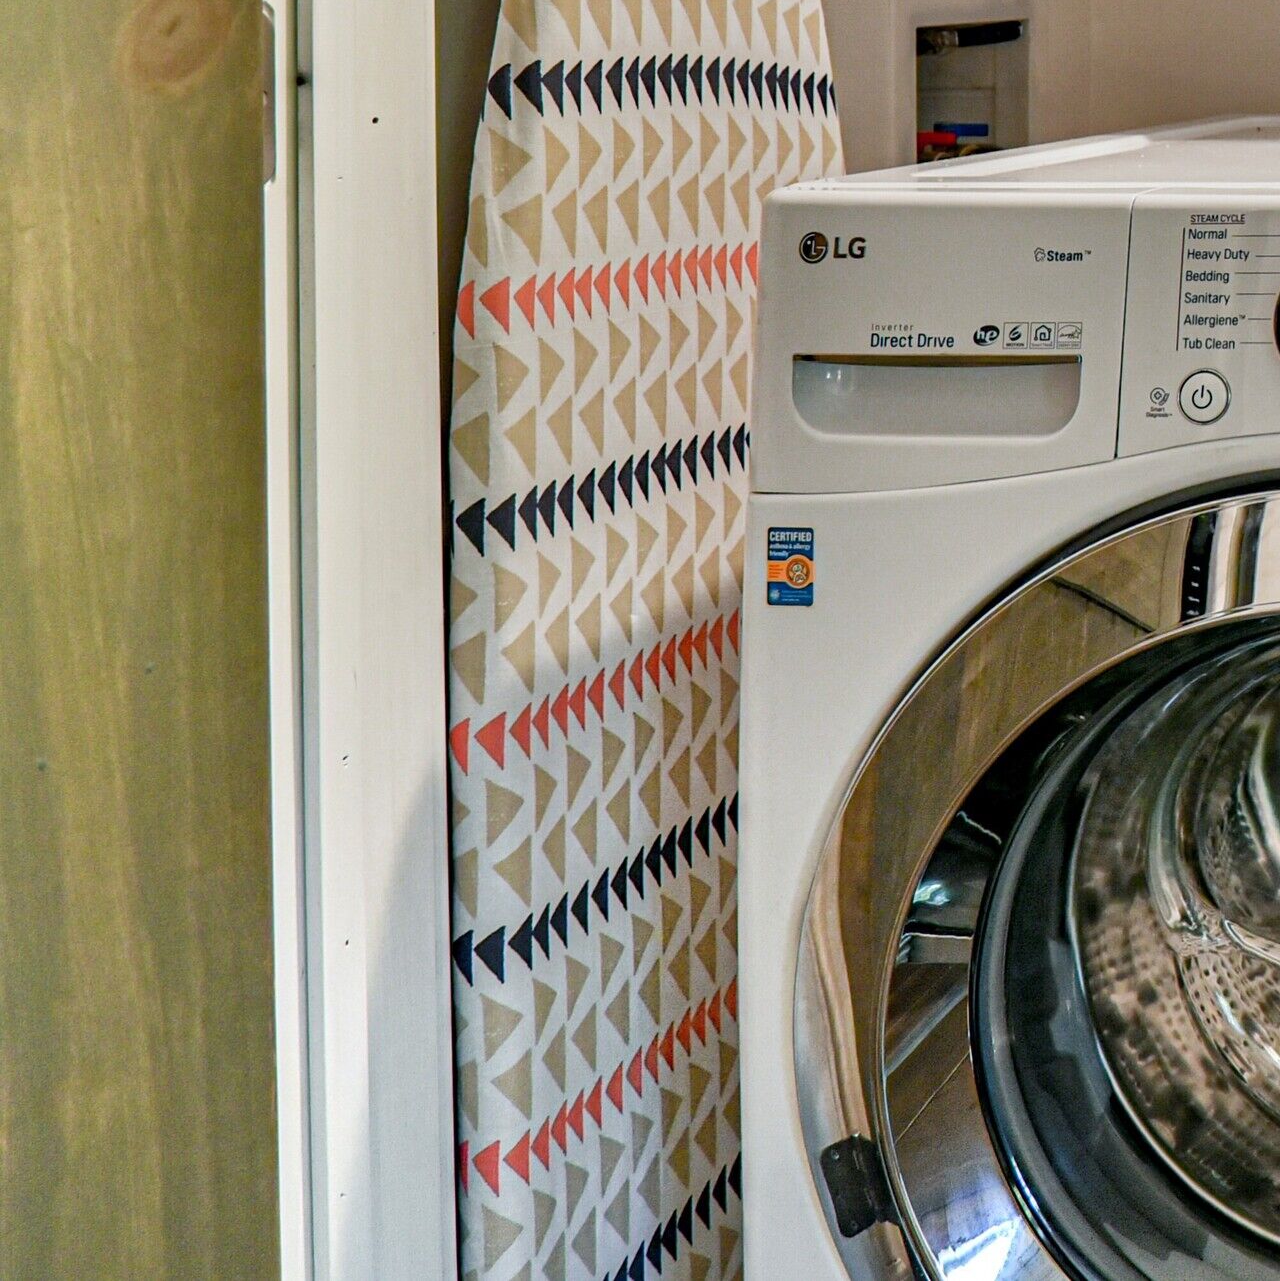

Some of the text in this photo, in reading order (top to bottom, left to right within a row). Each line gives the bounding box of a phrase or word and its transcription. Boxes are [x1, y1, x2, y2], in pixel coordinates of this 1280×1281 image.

[1191, 214, 1245, 222] STEAM CYCLE
[1188, 229, 1227, 239] Normal
[833, 236, 867, 259] LG
[1187, 249, 1249, 261] Heavy Duty
[1186, 271, 1229, 283] Bedding
[1184, 293, 1230, 305] Sanitary
[871, 323, 914, 332] Inverter
[871, 332, 954, 348] Direct Drive
[1183, 338, 1235, 349] Tub Clean
[769, 531, 812, 542] CERTIFIED
